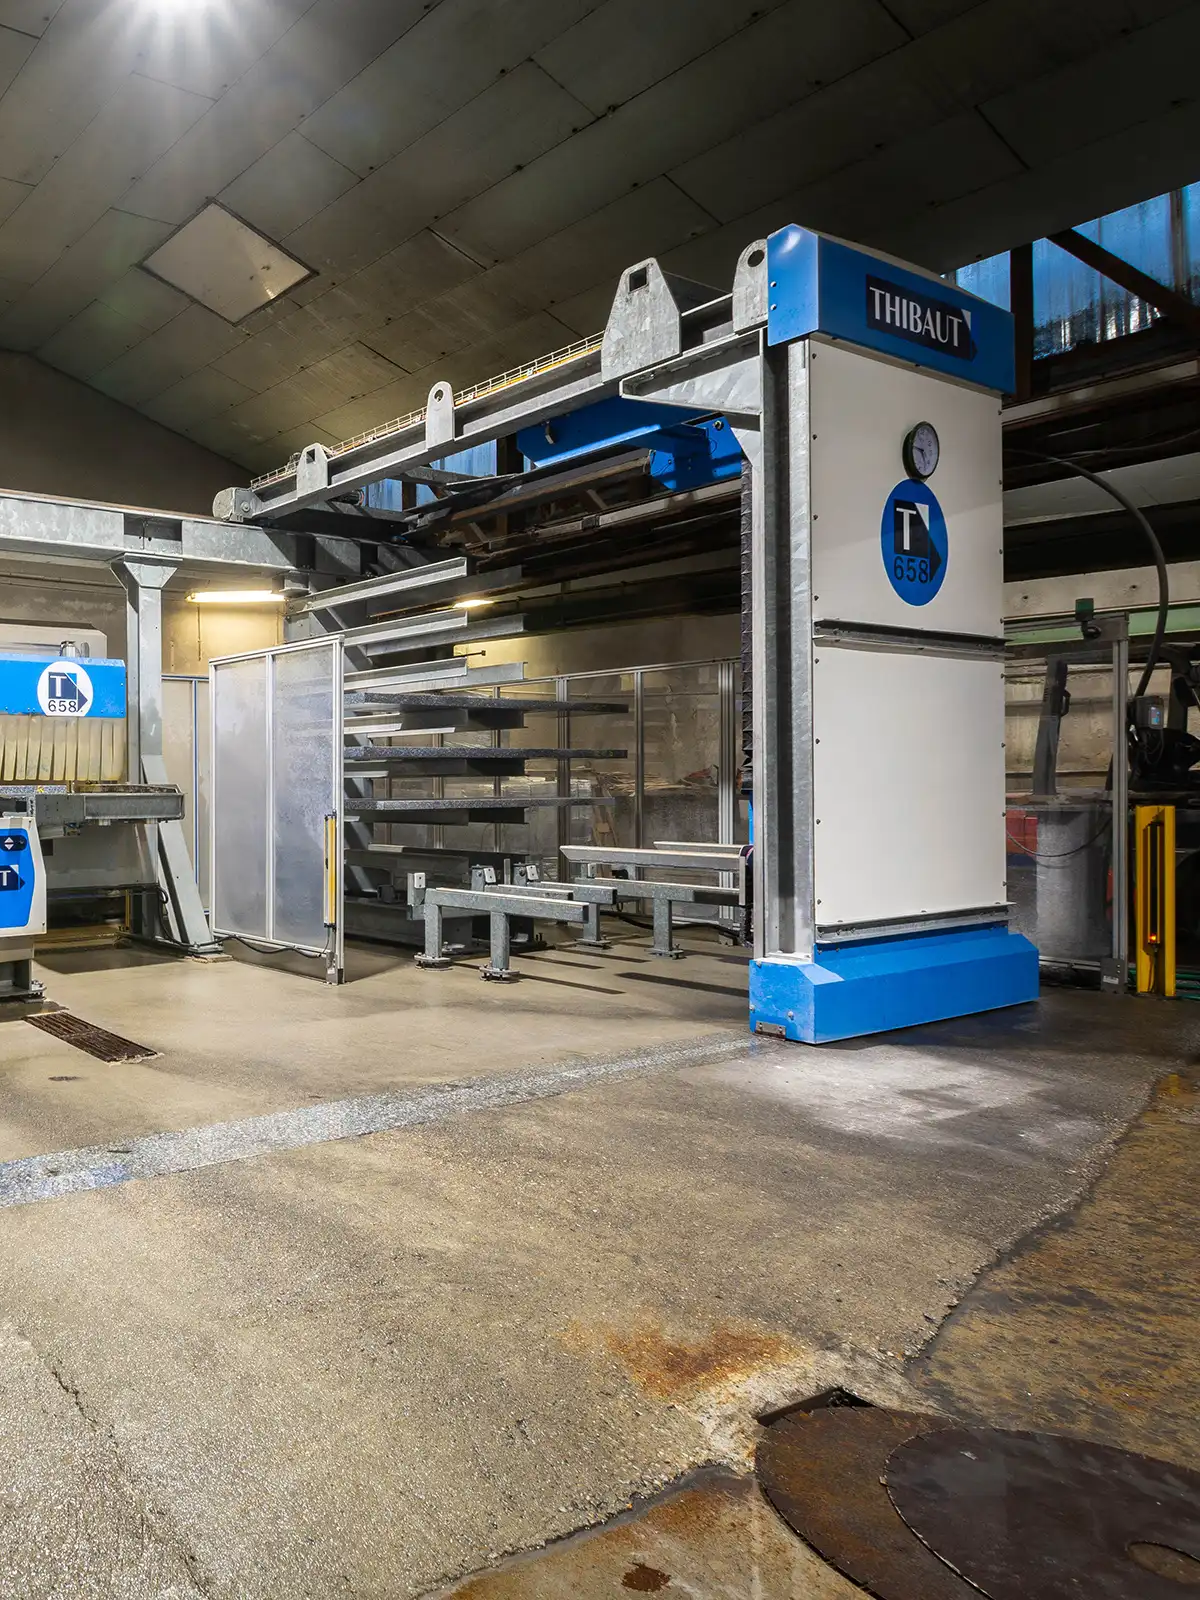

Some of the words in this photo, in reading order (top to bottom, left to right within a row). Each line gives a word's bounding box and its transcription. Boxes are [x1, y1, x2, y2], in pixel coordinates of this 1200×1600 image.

[869, 286, 963, 347] THIBAUT
[895, 507, 917, 551] T
[893, 555, 929, 584] 658
[49, 675, 67, 697] T
[48, 699, 77, 713] 658
